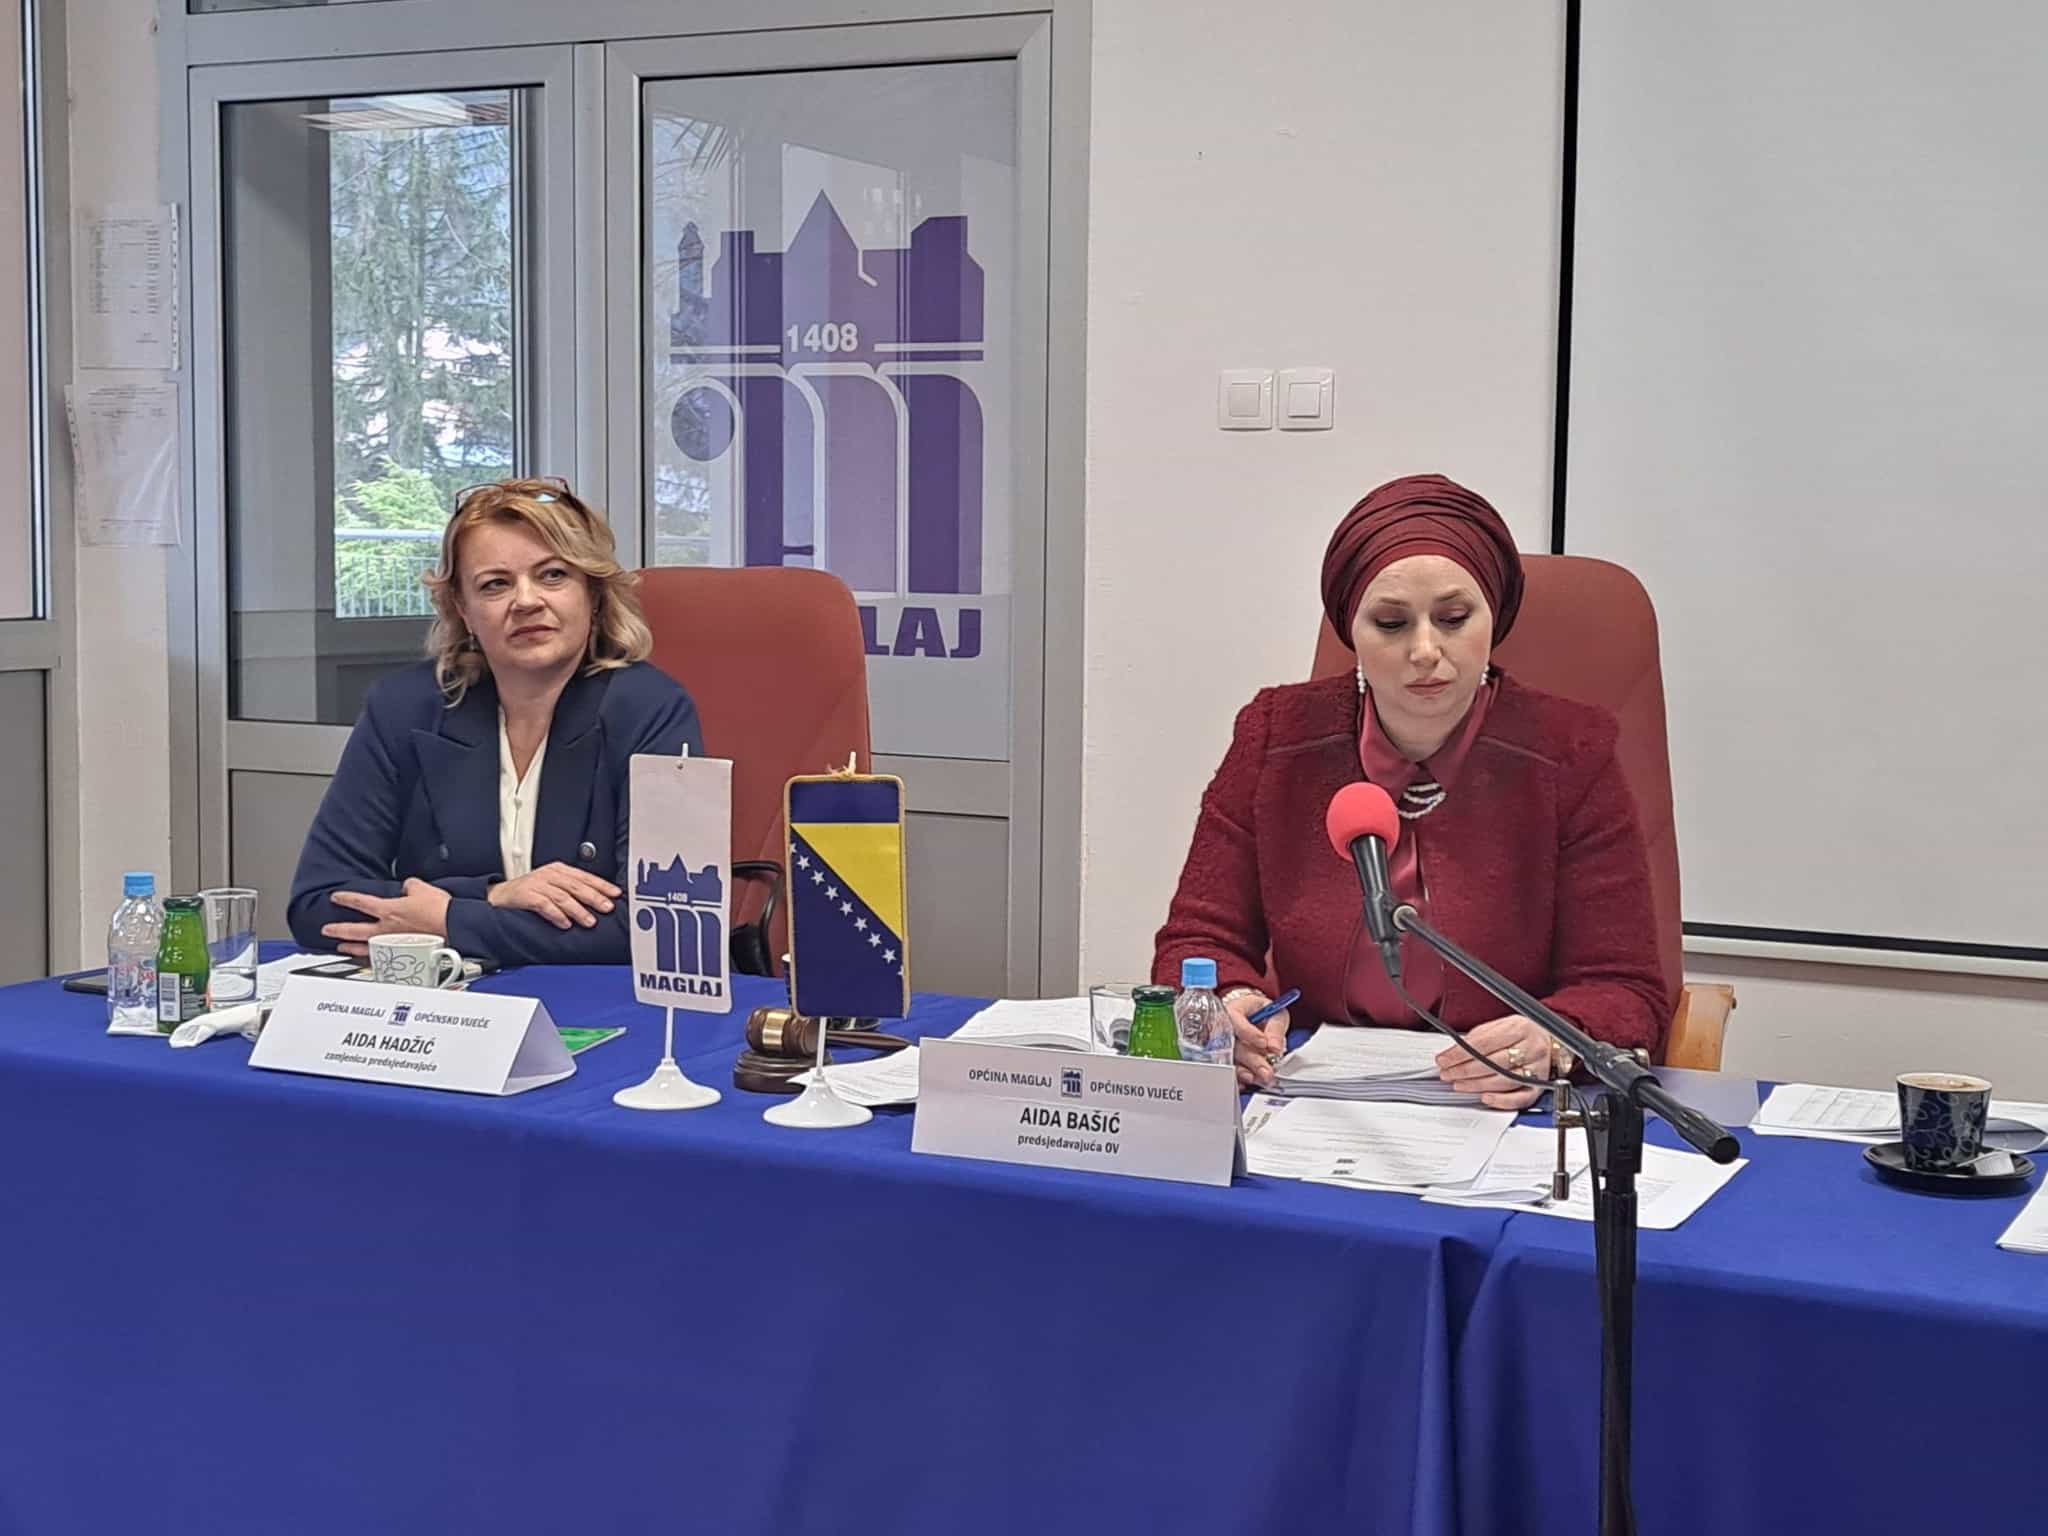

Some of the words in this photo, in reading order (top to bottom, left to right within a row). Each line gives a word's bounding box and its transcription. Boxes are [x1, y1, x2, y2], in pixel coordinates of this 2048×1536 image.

[785, 322, 858, 352] 1408
[858, 606, 982, 658] LAJ
[667, 891, 688, 903] 1408
[640, 973, 722, 997] MAGLAJ
[317, 1002, 349, 1015] OPĆINA
[350, 1006, 386, 1018] MAGLAJ
[414, 1011, 459, 1026] OPĆINSKO
[342, 1032, 376, 1049] AIDA
[379, 1035, 436, 1055] HADŽIĆ
[324, 1052, 367, 1064] zamjenica
[368, 1056, 437, 1072] predsjedavajuće
[969, 1068, 1008, 1083] OPĆINA
[1010, 1073, 1052, 1088] MAGLAJ
[1090, 1080, 1145, 1097] OPĆINSKO
[1147, 1086, 1184, 1101] VIJEĆE
[1019, 1107, 1062, 1128] AIDA
[1066, 1109, 1120, 1134] BAŠIĆ
[1017, 1135, 1102, 1152] predsjedavajuća
[1105, 1142, 1120, 1154] OV
